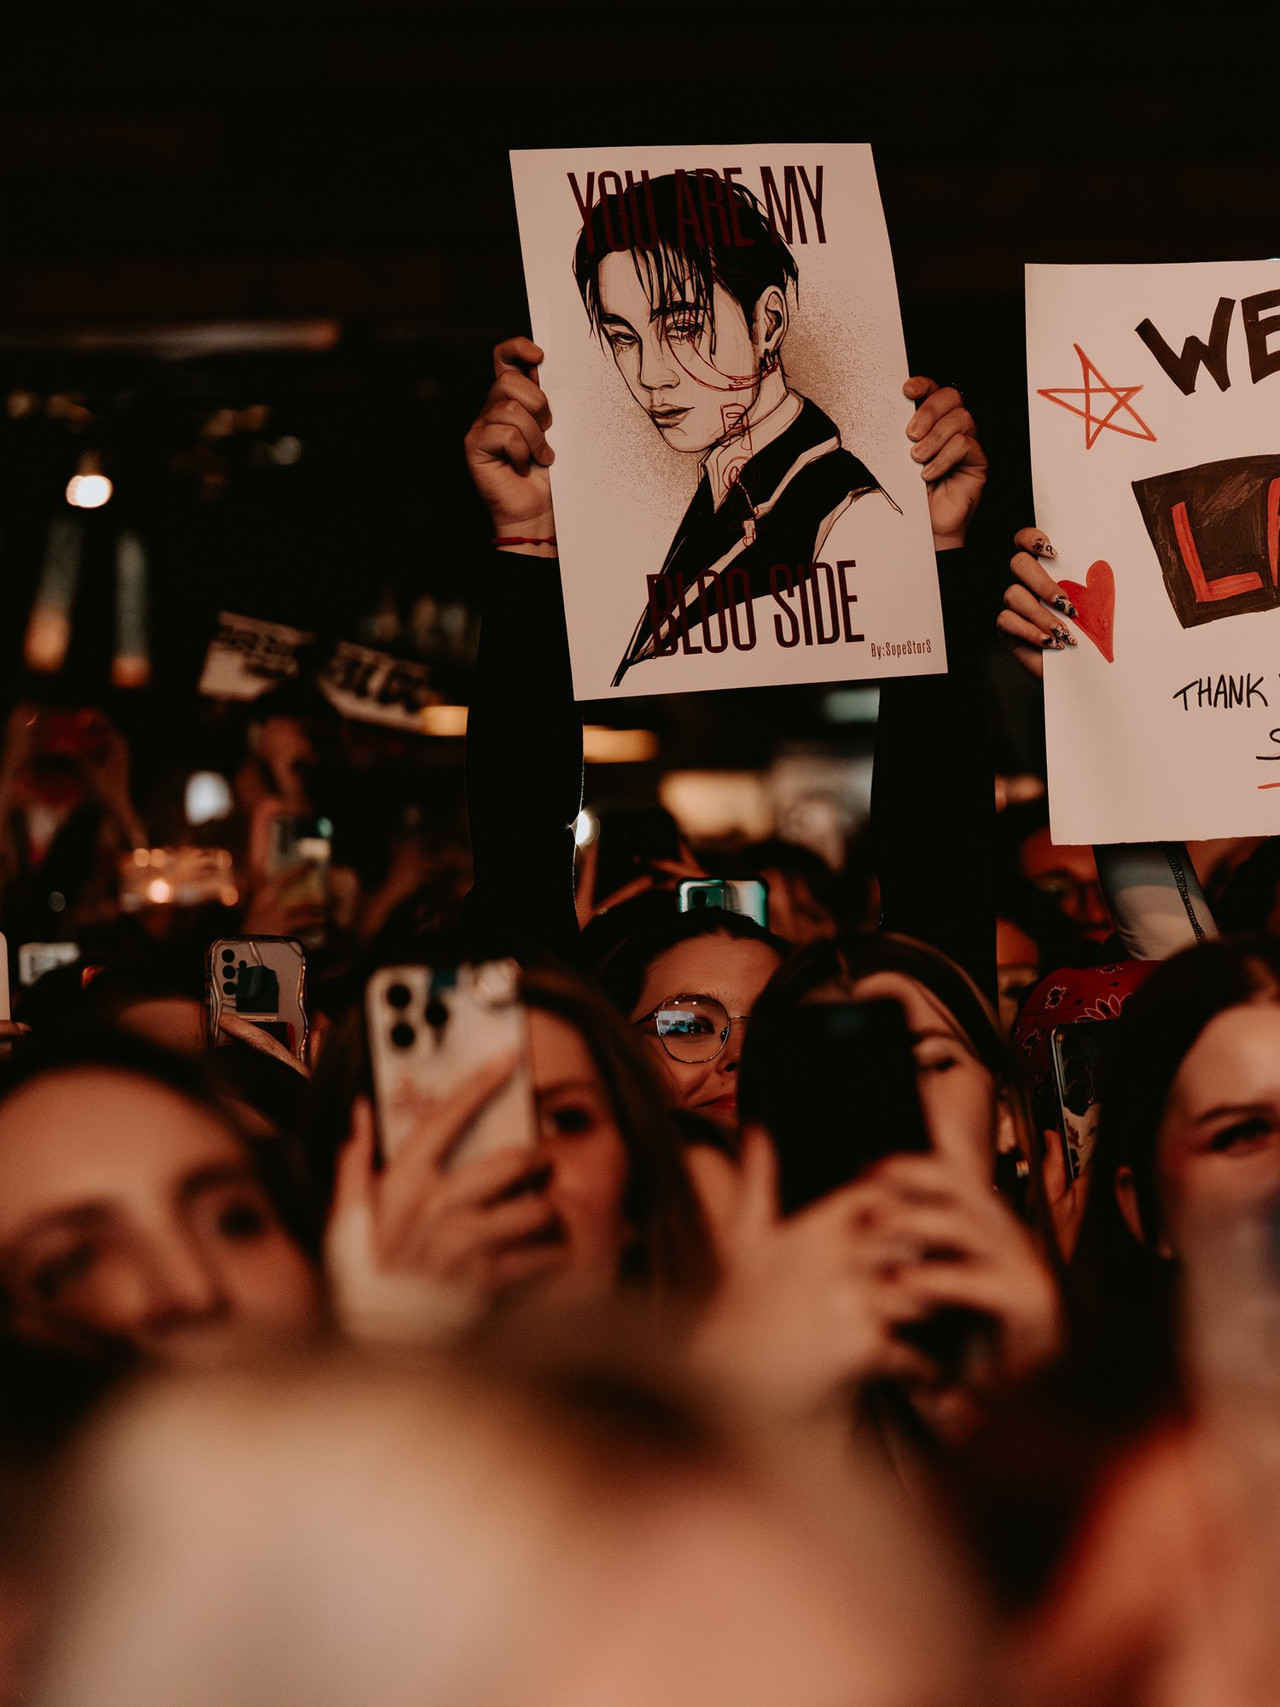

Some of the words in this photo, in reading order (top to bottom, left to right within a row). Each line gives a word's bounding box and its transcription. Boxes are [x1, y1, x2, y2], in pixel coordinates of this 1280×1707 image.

[567, 170, 660, 254] YOU
[675, 167, 755, 249] ARE
[760, 165, 826, 246] MY
[646, 567, 757, 657] BLOO
[768, 560, 865, 648] SIDE
[1172, 673, 1268, 711] THANK
